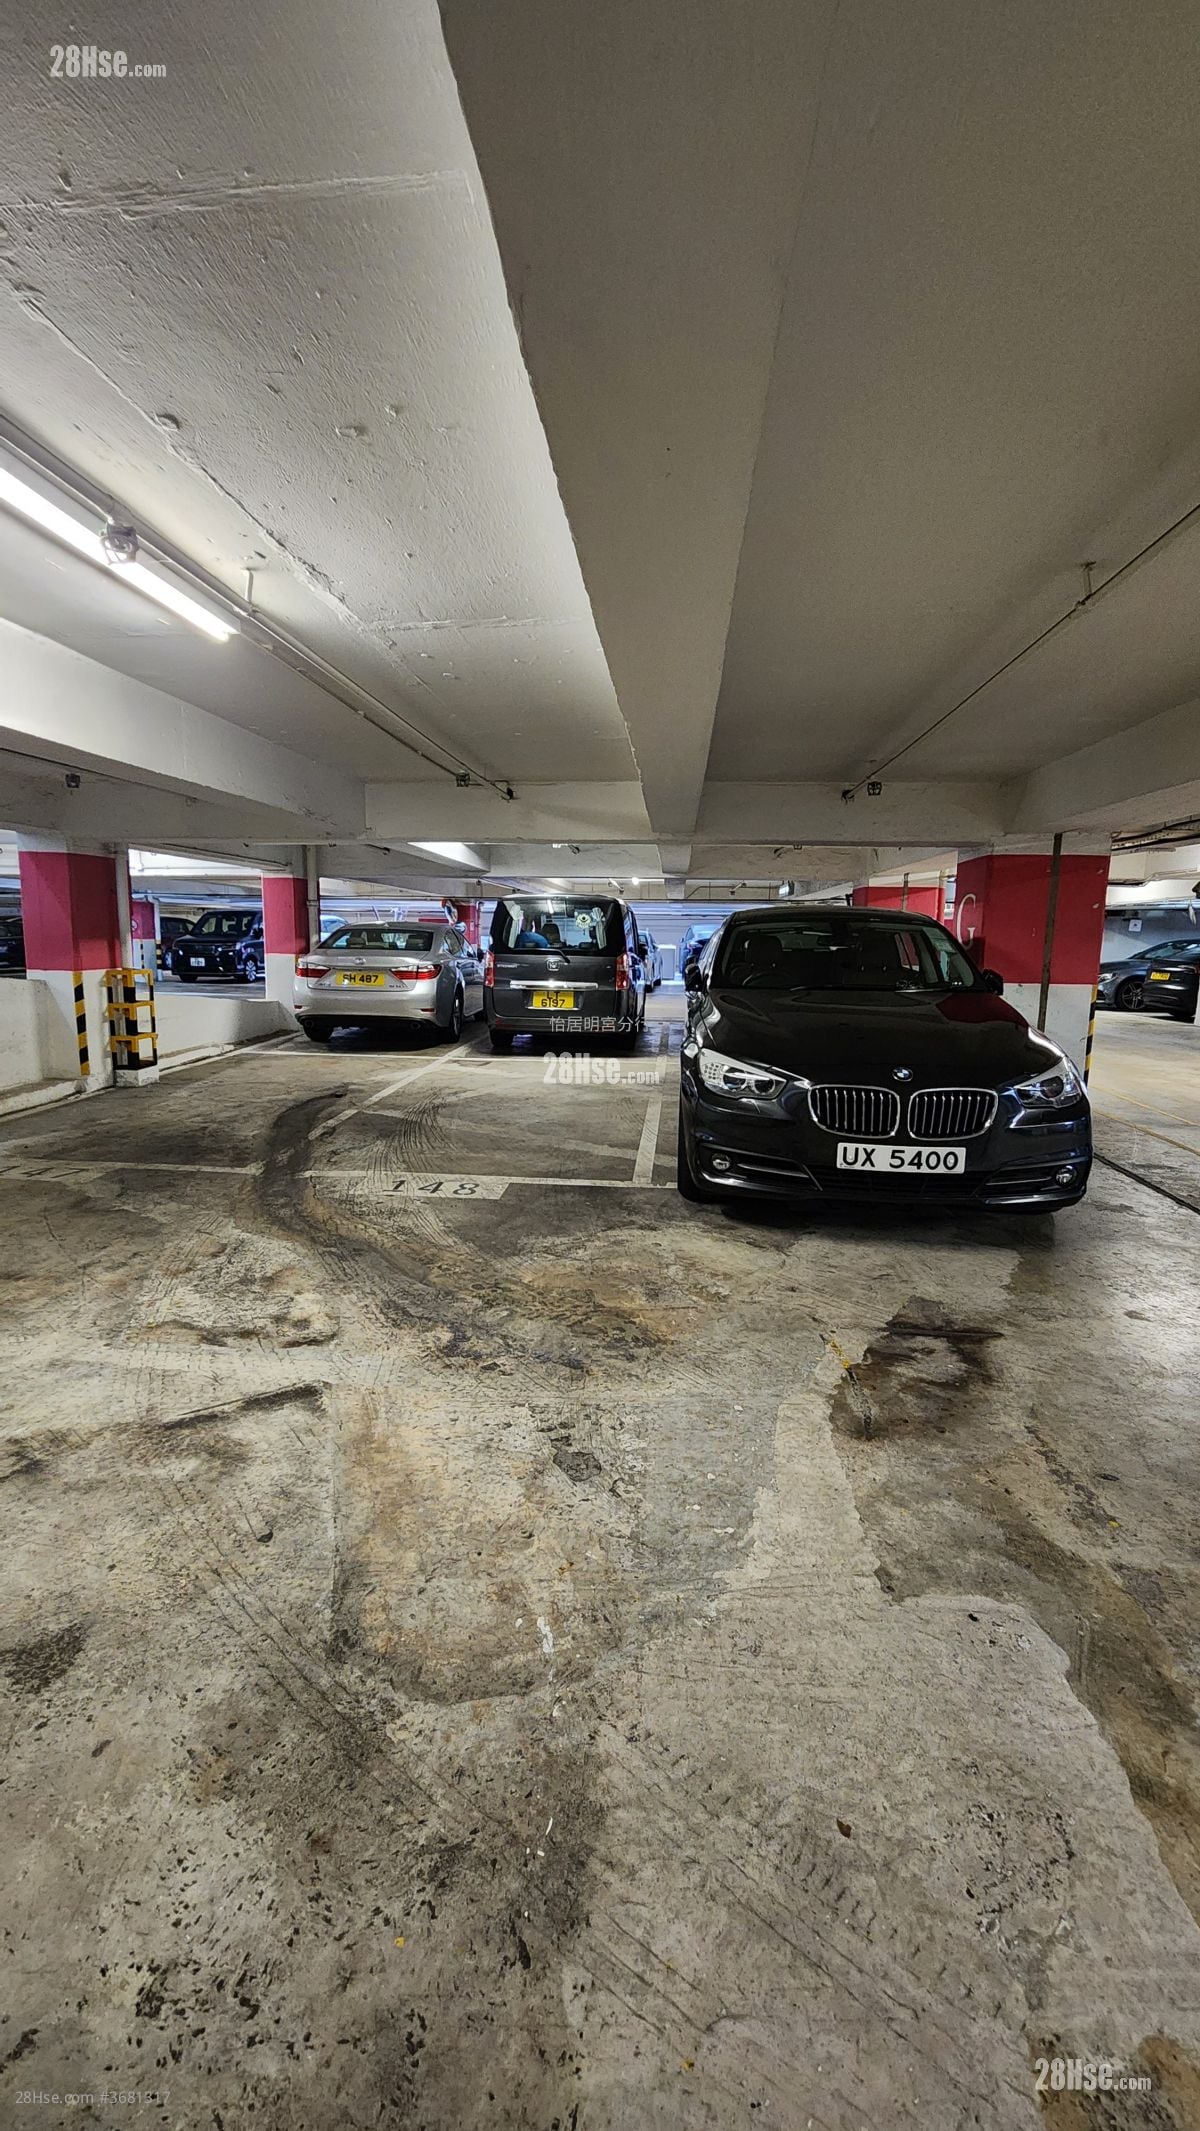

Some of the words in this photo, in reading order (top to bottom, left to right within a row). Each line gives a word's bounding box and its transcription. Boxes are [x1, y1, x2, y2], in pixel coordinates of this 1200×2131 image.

[956, 893, 977, 950] G
[358, 974, 379, 984] 487
[541, 999, 566, 1008] 6197
[842, 1146, 876, 1167] UX
[889, 1149, 959, 1171] 5400
[382, 1179, 480, 1196] 148
